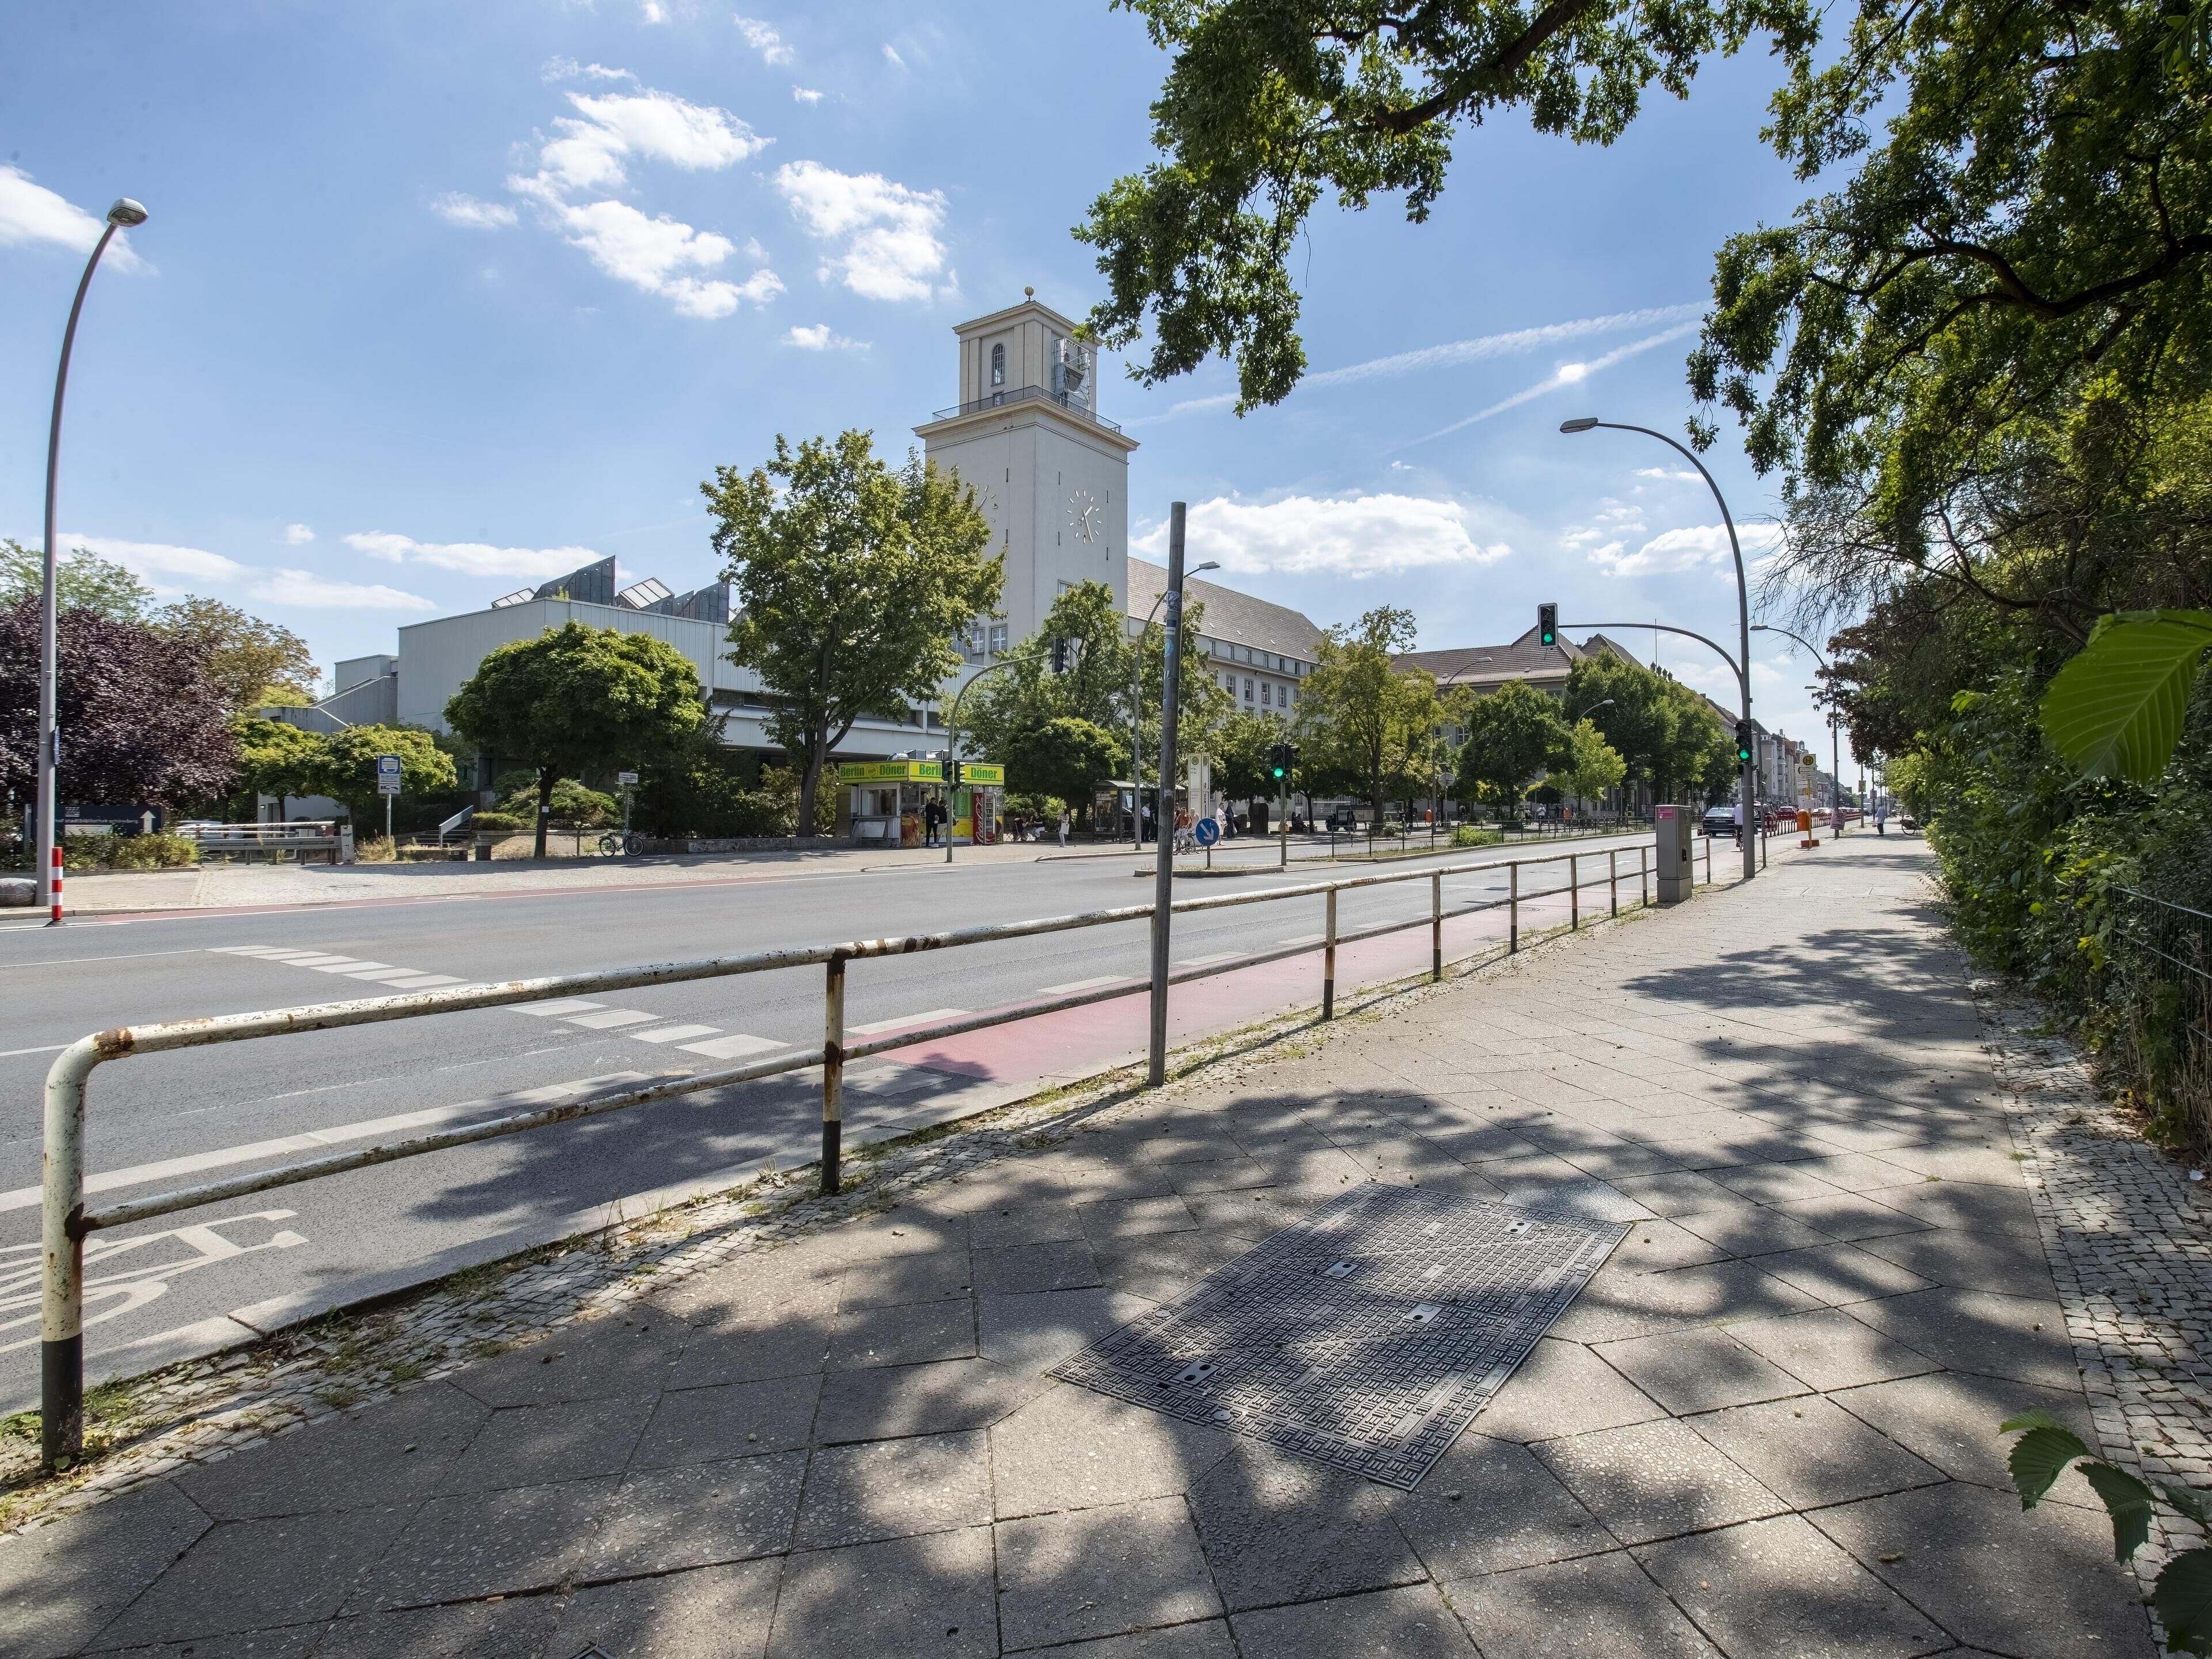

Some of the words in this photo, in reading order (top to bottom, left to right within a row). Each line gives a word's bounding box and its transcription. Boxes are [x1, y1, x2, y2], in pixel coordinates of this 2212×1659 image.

[840, 766, 865, 777] Berlin
[880, 764, 906, 775] Döner
[919, 763, 942, 776] Berli
[971, 767, 998, 779] Döner
[975, 794, 984, 844] Coca-Cola
